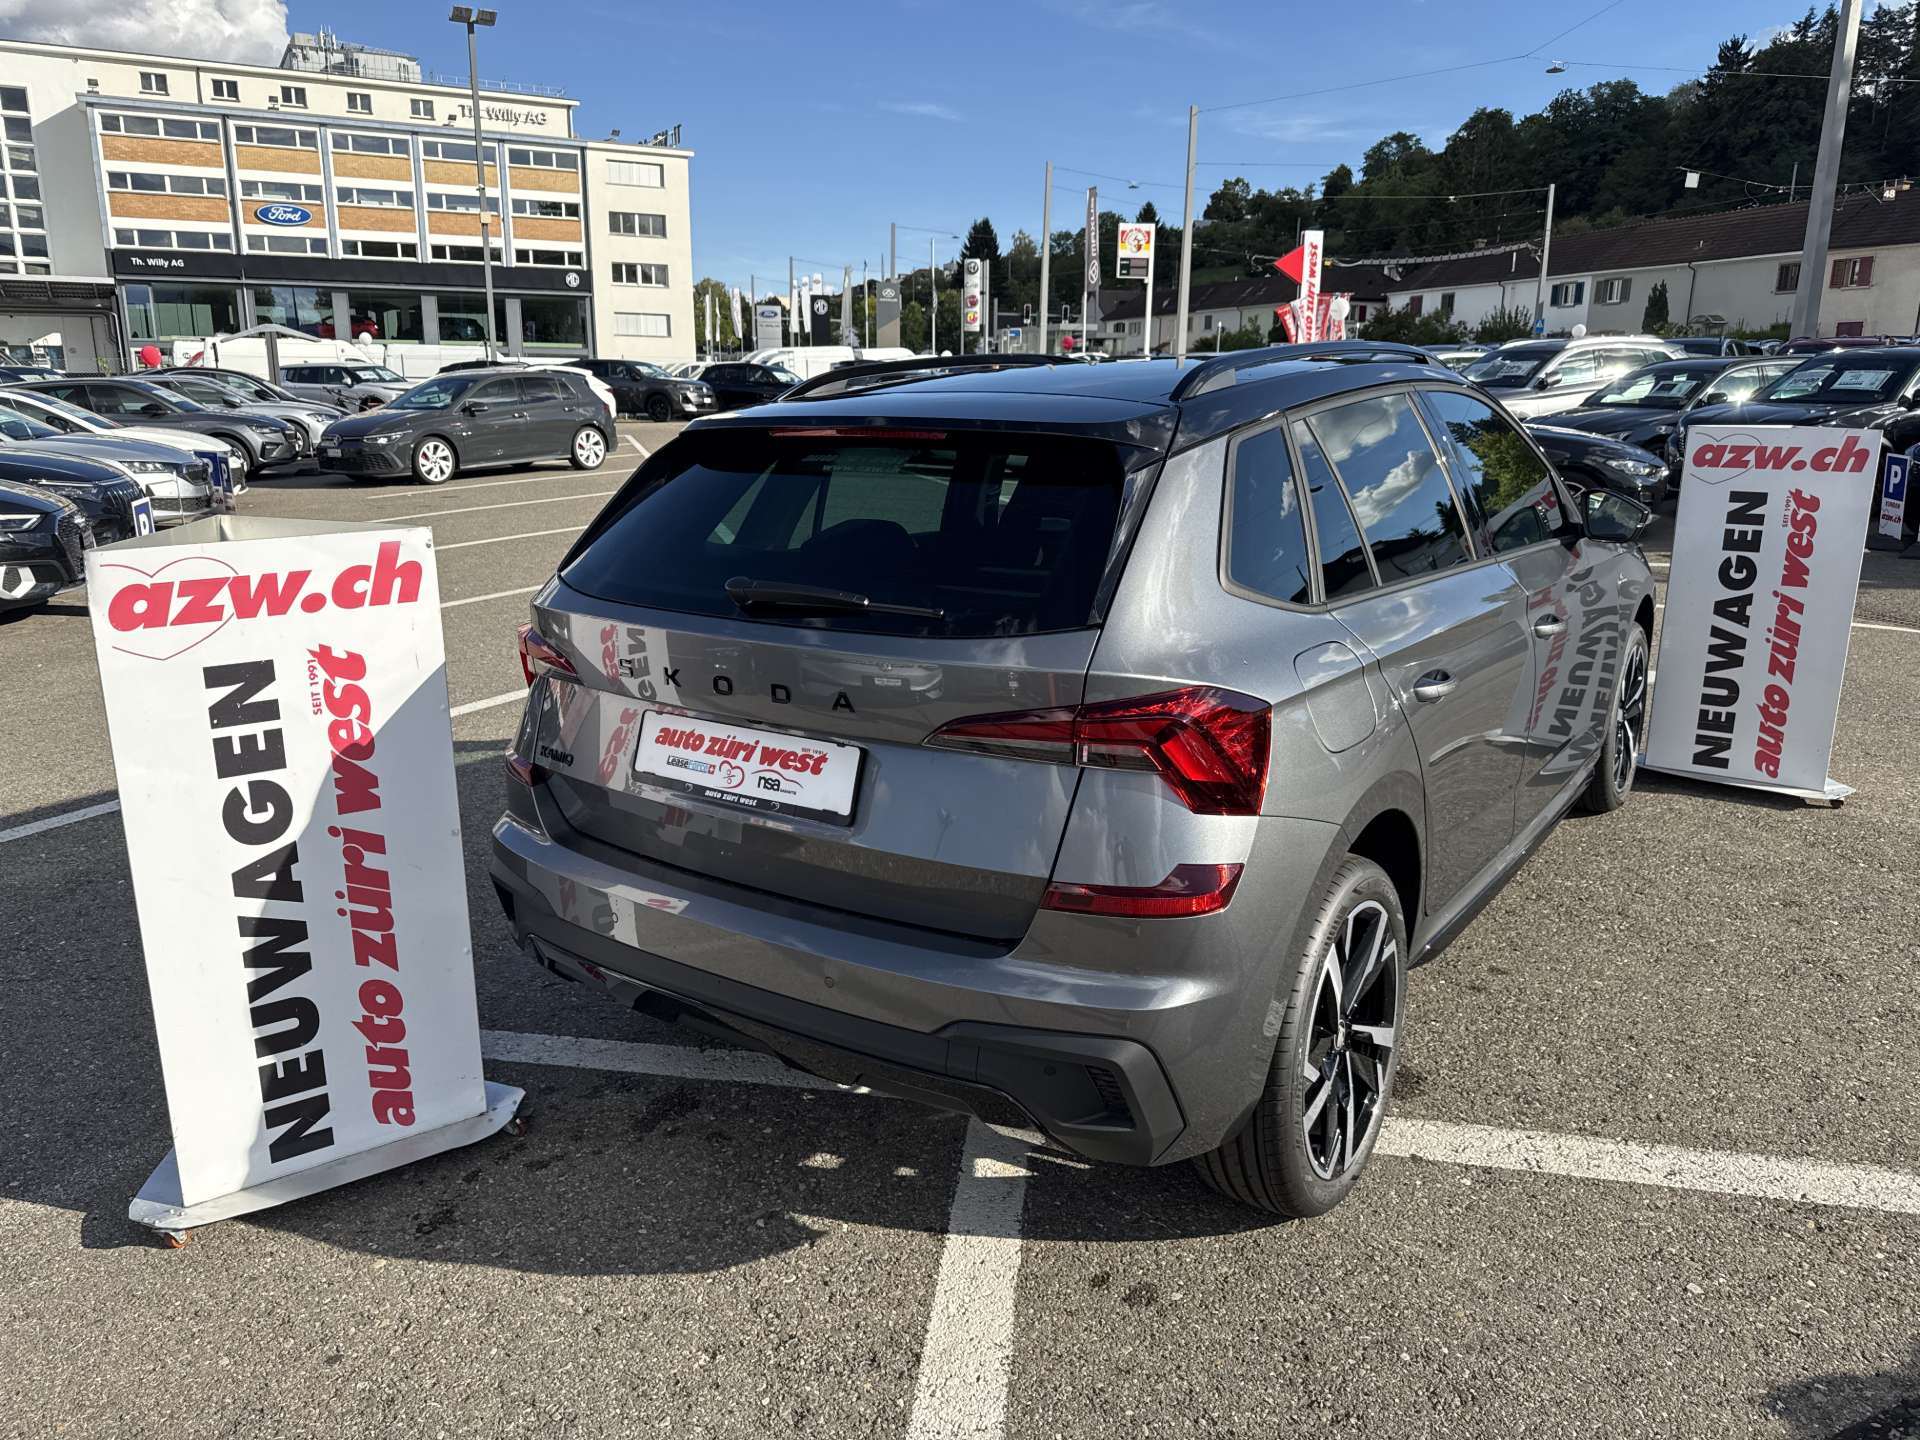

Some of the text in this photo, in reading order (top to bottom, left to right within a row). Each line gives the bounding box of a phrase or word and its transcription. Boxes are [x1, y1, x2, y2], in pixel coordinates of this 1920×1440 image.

[268, 207, 302, 222] Ford
[130, 258, 185, 268] Th. Willy AG
[566, 273, 580, 287] MG
[814, 299, 828, 315] MG
[1692, 435, 1871, 473] azw.ch
[1888, 464, 1902, 493] P
[108, 541, 423, 631] azw.ch
[1692, 490, 1769, 769] NEUWAGEN
[1754, 488, 1821, 779] auto züri west
[307, 659, 323, 715] SEIT 1991
[540, 744, 575, 767] KAMIQ
[655, 726, 829, 776] auto züri west
[704, 789, 758, 807] auto züri west
[757, 775, 781, 792] nsa
[306, 643, 416, 1127] auto züri west
[203, 659, 335, 1164] NEUWAGEN
